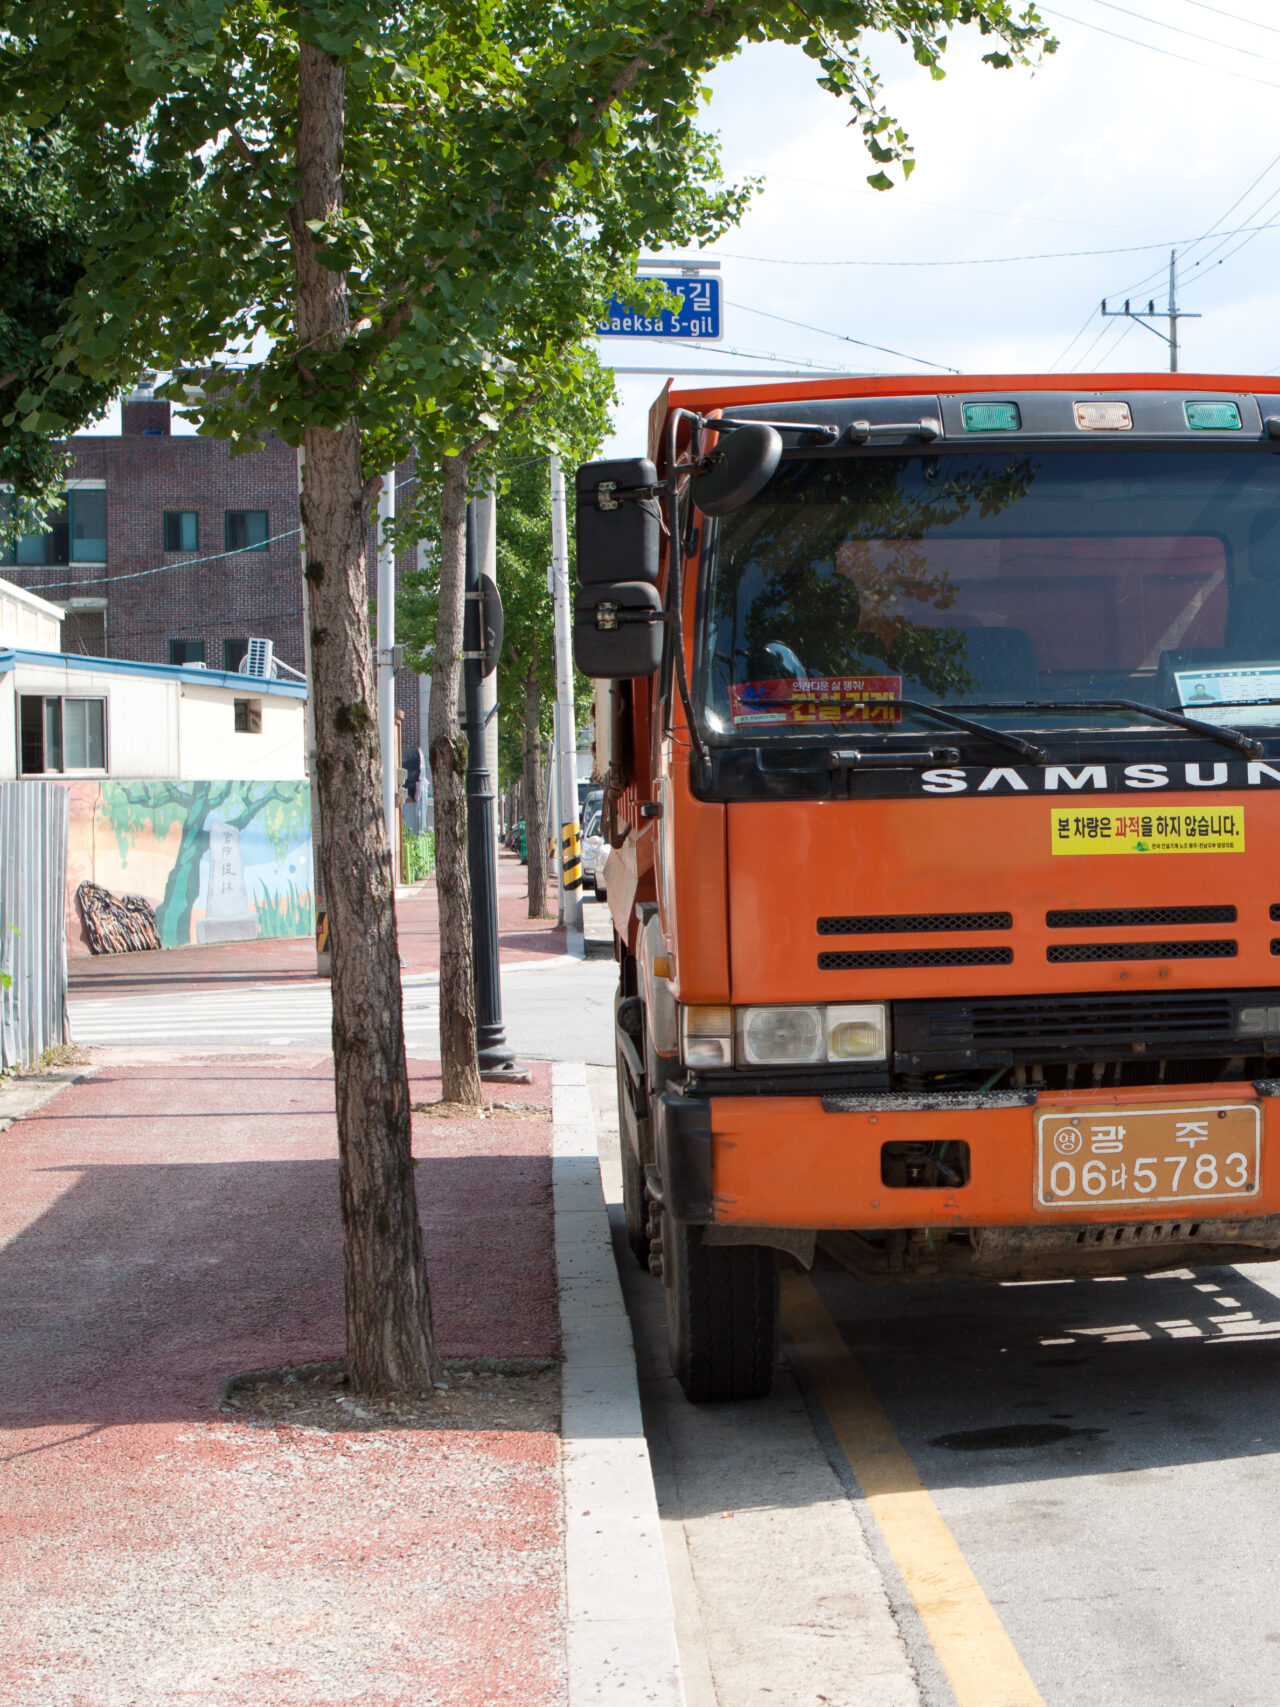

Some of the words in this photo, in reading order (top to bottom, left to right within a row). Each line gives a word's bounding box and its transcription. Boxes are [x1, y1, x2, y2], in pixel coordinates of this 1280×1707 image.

[670, 316, 713, 337] 5-gil
[1058, 818, 1070, 838] 본
[1073, 816, 1111, 838] 차량은
[1115, 816, 1152, 838] 과적을
[1156, 816, 1181, 837] 하지
[1184, 815, 1239, 837] 않습니다.
[1050, 1152, 1248, 1197] 06다5783
